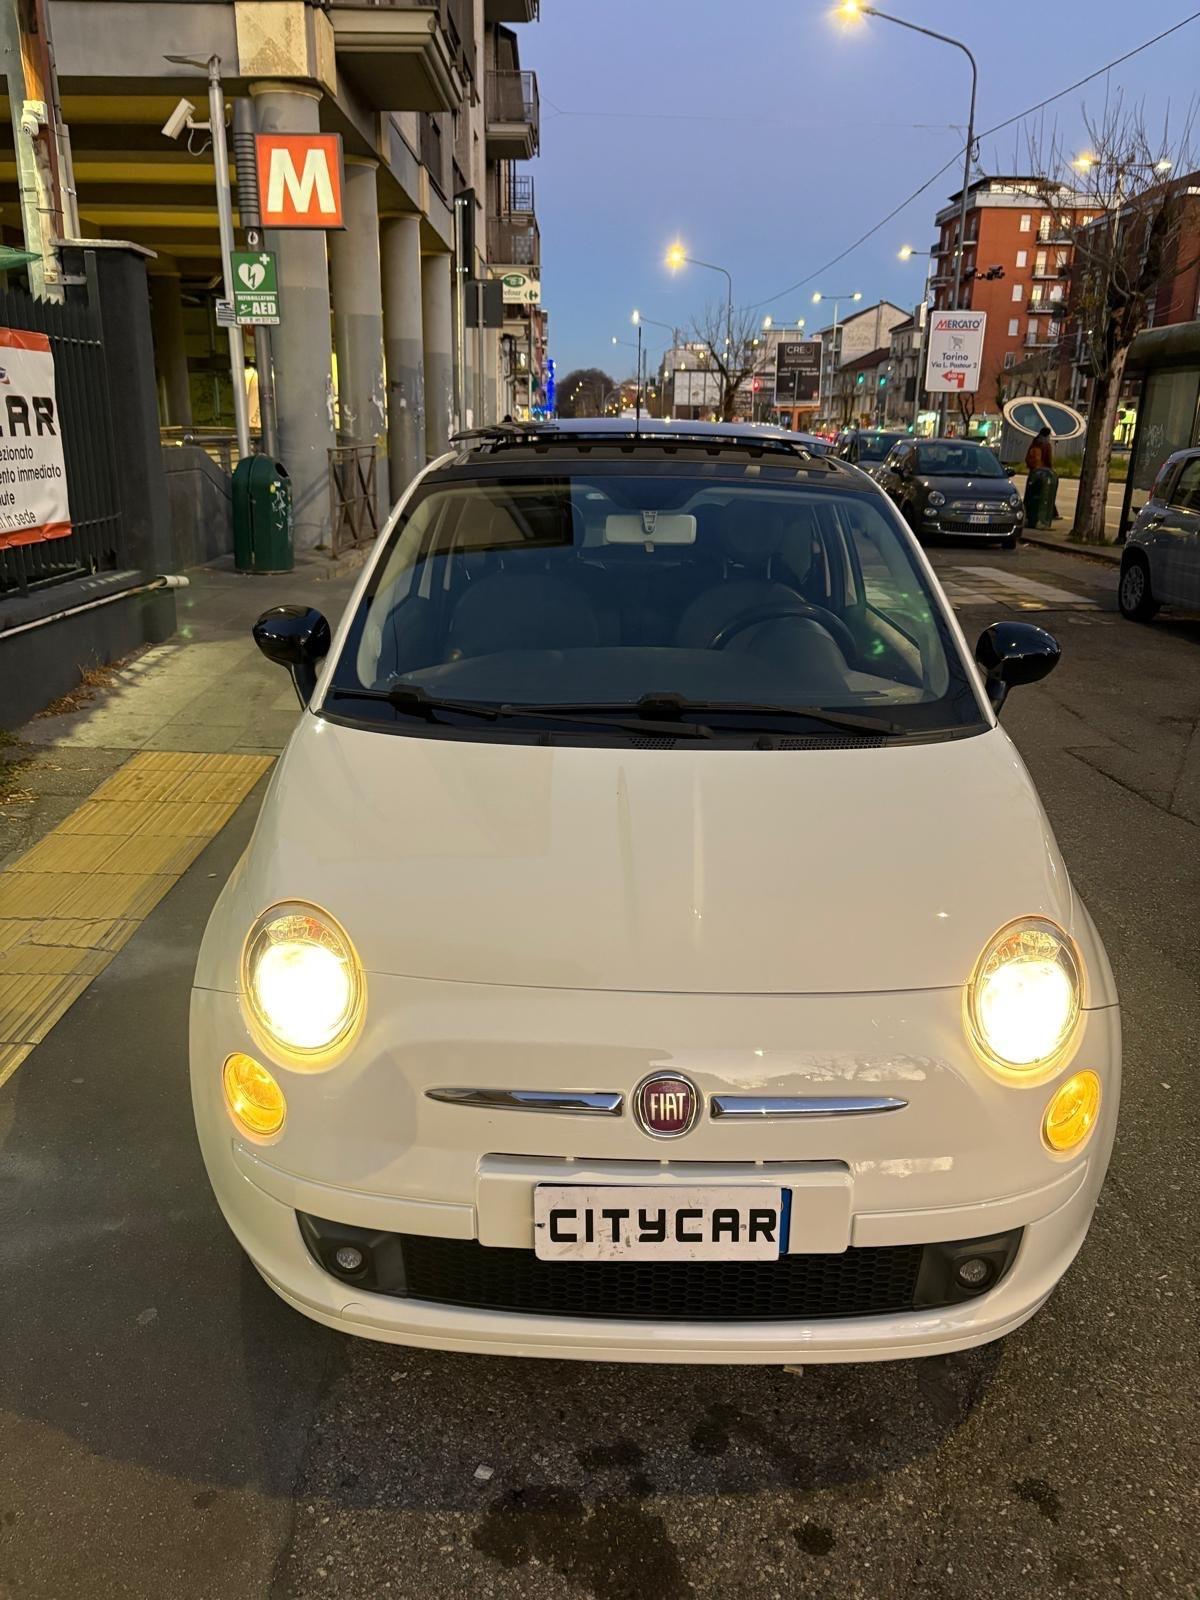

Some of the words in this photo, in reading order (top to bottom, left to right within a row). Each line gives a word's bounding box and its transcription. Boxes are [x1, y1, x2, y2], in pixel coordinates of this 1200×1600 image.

[267, 149, 336, 213] M
[252, 302, 276, 315] AED
[942, 352, 968, 361] Torino
[0, 395, 56, 436] AR
[17, 464, 61, 482] immediato
[3, 513, 15, 527] in
[14, 509, 36, 525] sede
[650, 1093, 686, 1120] FIAT
[550, 1209, 777, 1242] CITYCAR
